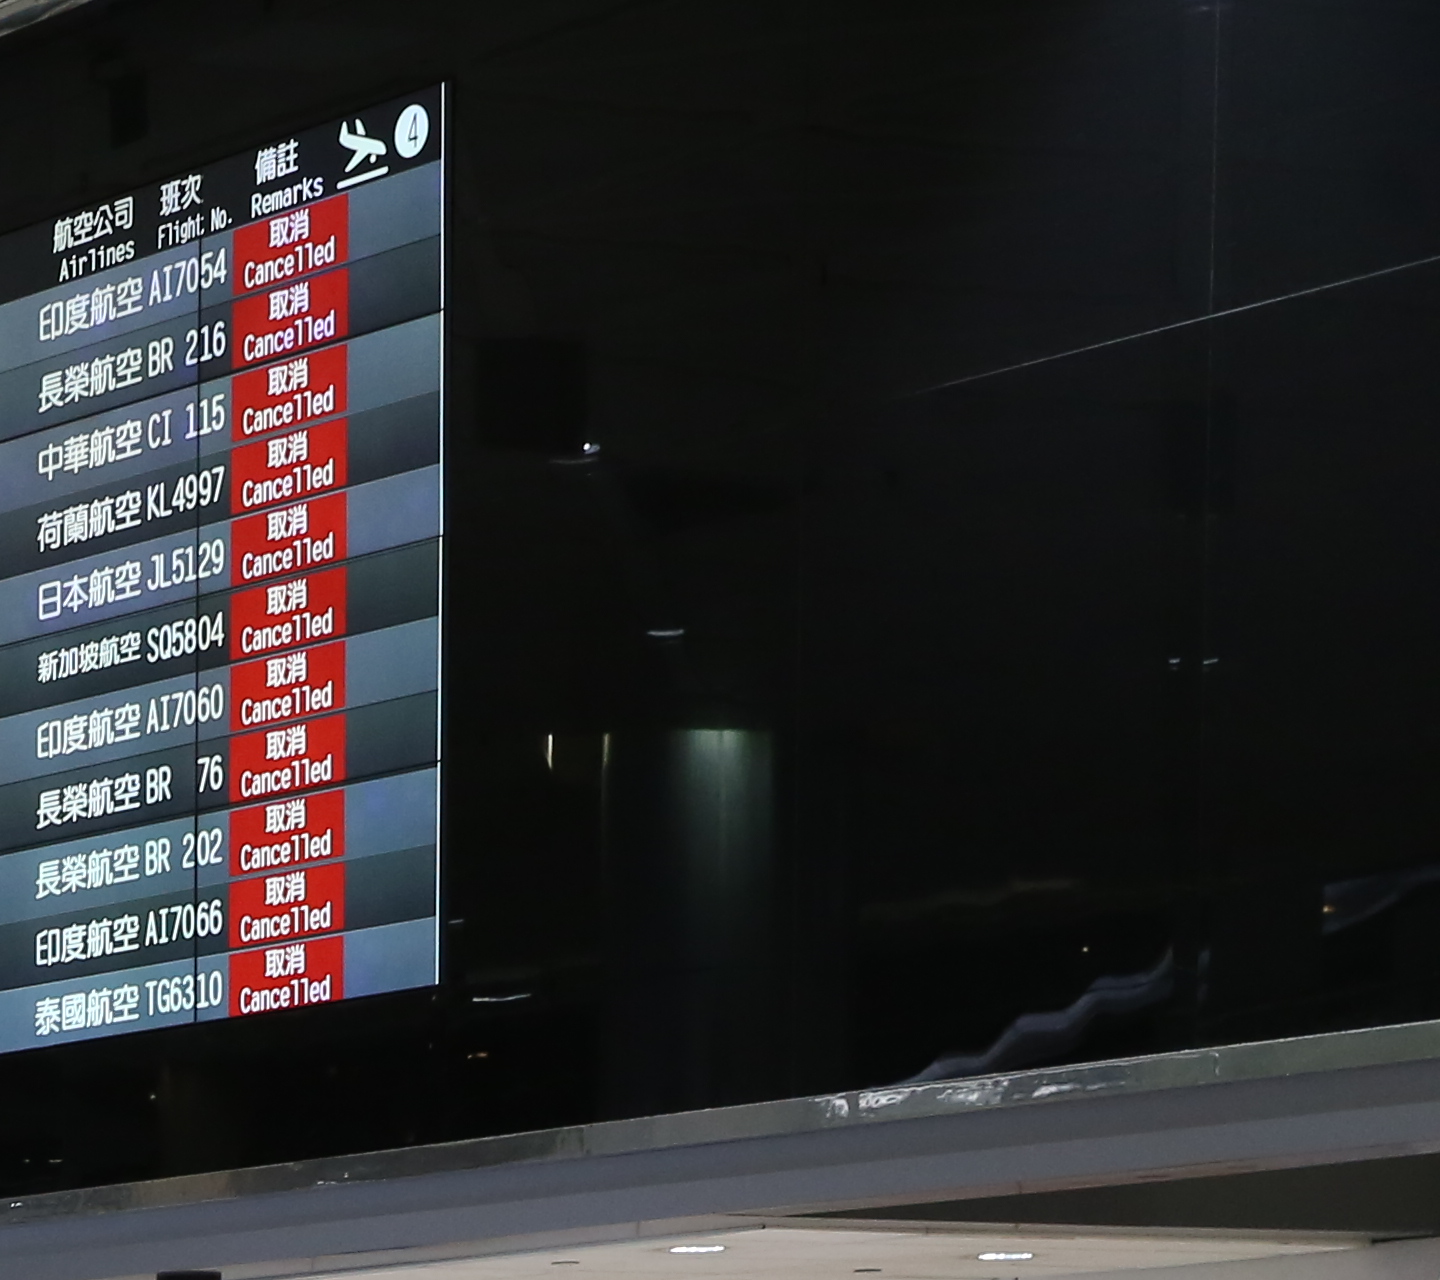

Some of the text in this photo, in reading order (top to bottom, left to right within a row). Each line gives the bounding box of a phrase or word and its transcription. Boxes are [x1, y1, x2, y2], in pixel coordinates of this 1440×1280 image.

[53, 138, 299, 253] 航空公司 班次 備註
[59, 175, 324, 282] Airlines Flight No. Remarks
[269, 209, 310, 248] 取消
[244, 236, 336, 289] Cancelled
[38, 276, 143, 342] 印度航空
[148, 247, 228, 307] AI7054
[268, 282, 310, 321] 取消
[243, 310, 335, 362] Cancelled
[37, 347, 142, 413] 長榮航空
[148, 337, 173, 378] BR
[185, 321, 226, 366] 216
[267, 430, 308, 468] 取消
[242, 458, 334, 508] Cancelled
[36, 490, 142, 553] 荷蘭航空
[146, 466, 226, 522] KL4997
[266, 578, 307, 616] 取消
[37, 631, 141, 684] 新加坡航空
[146, 611, 225, 663] SQ5804
[242, 607, 333, 653] Cancelled
[266, 651, 307, 688] 取消
[36, 702, 141, 760] 印度航空
[146, 684, 224, 735] AI7060
[242, 680, 333, 726] Cancelled
